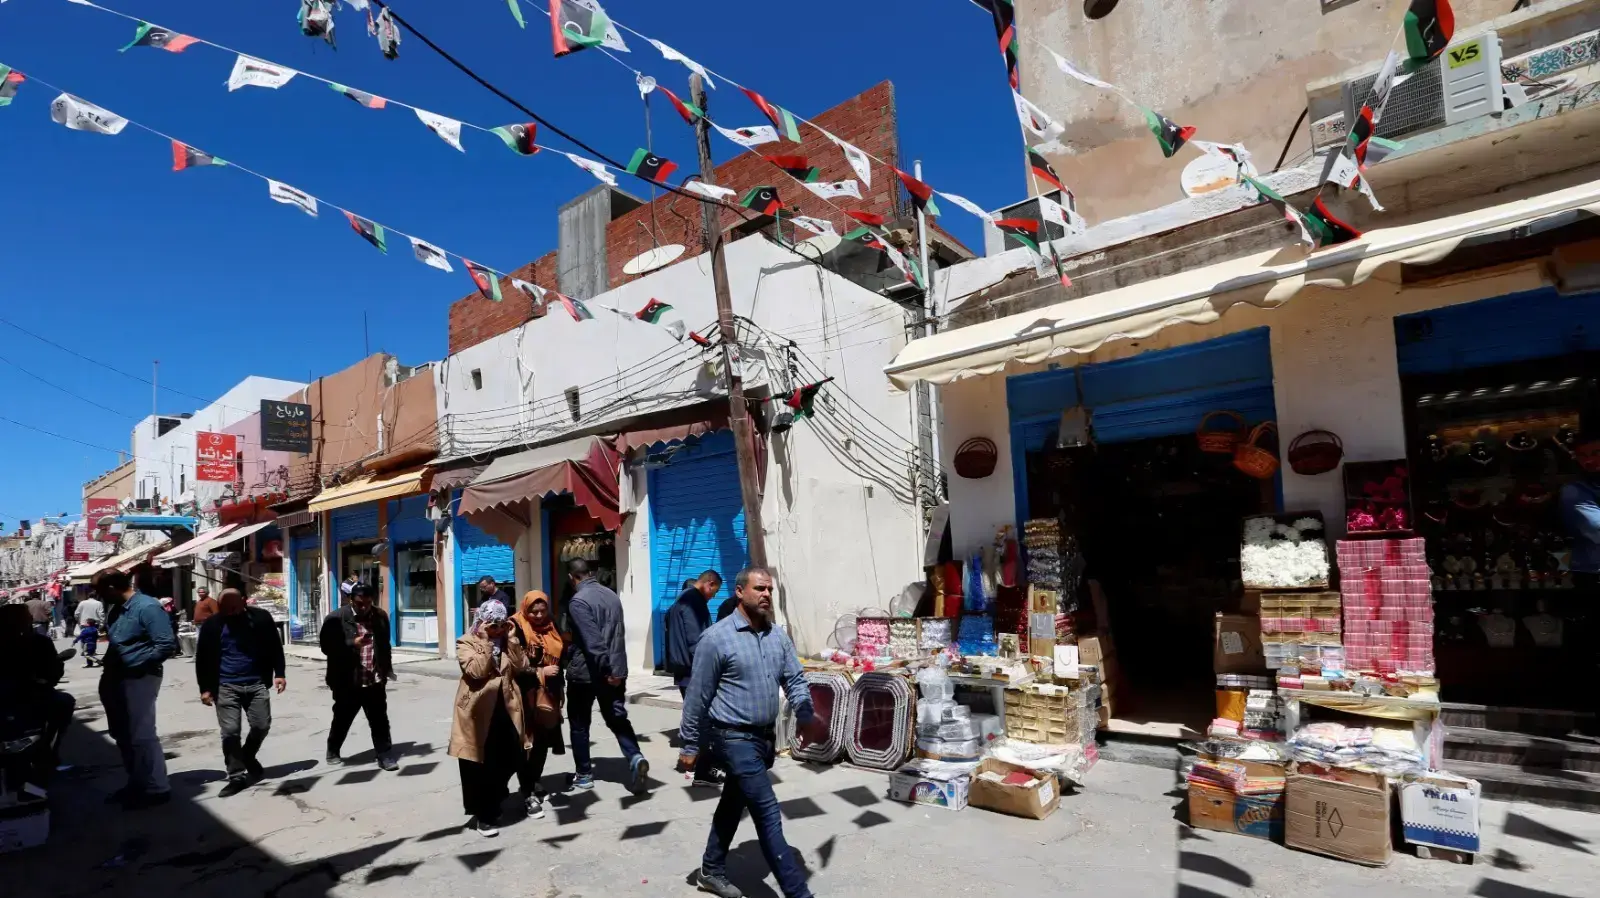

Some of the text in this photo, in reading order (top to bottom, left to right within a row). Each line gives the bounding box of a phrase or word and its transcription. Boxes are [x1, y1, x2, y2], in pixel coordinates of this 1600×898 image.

[1449, 44, 1479, 62] V.5
[1339, 169, 1348, 180] 17
[276, 405, 305, 418] مارياج
[213, 436, 220, 444] 2
[198, 446, 233, 462] تراثنا
